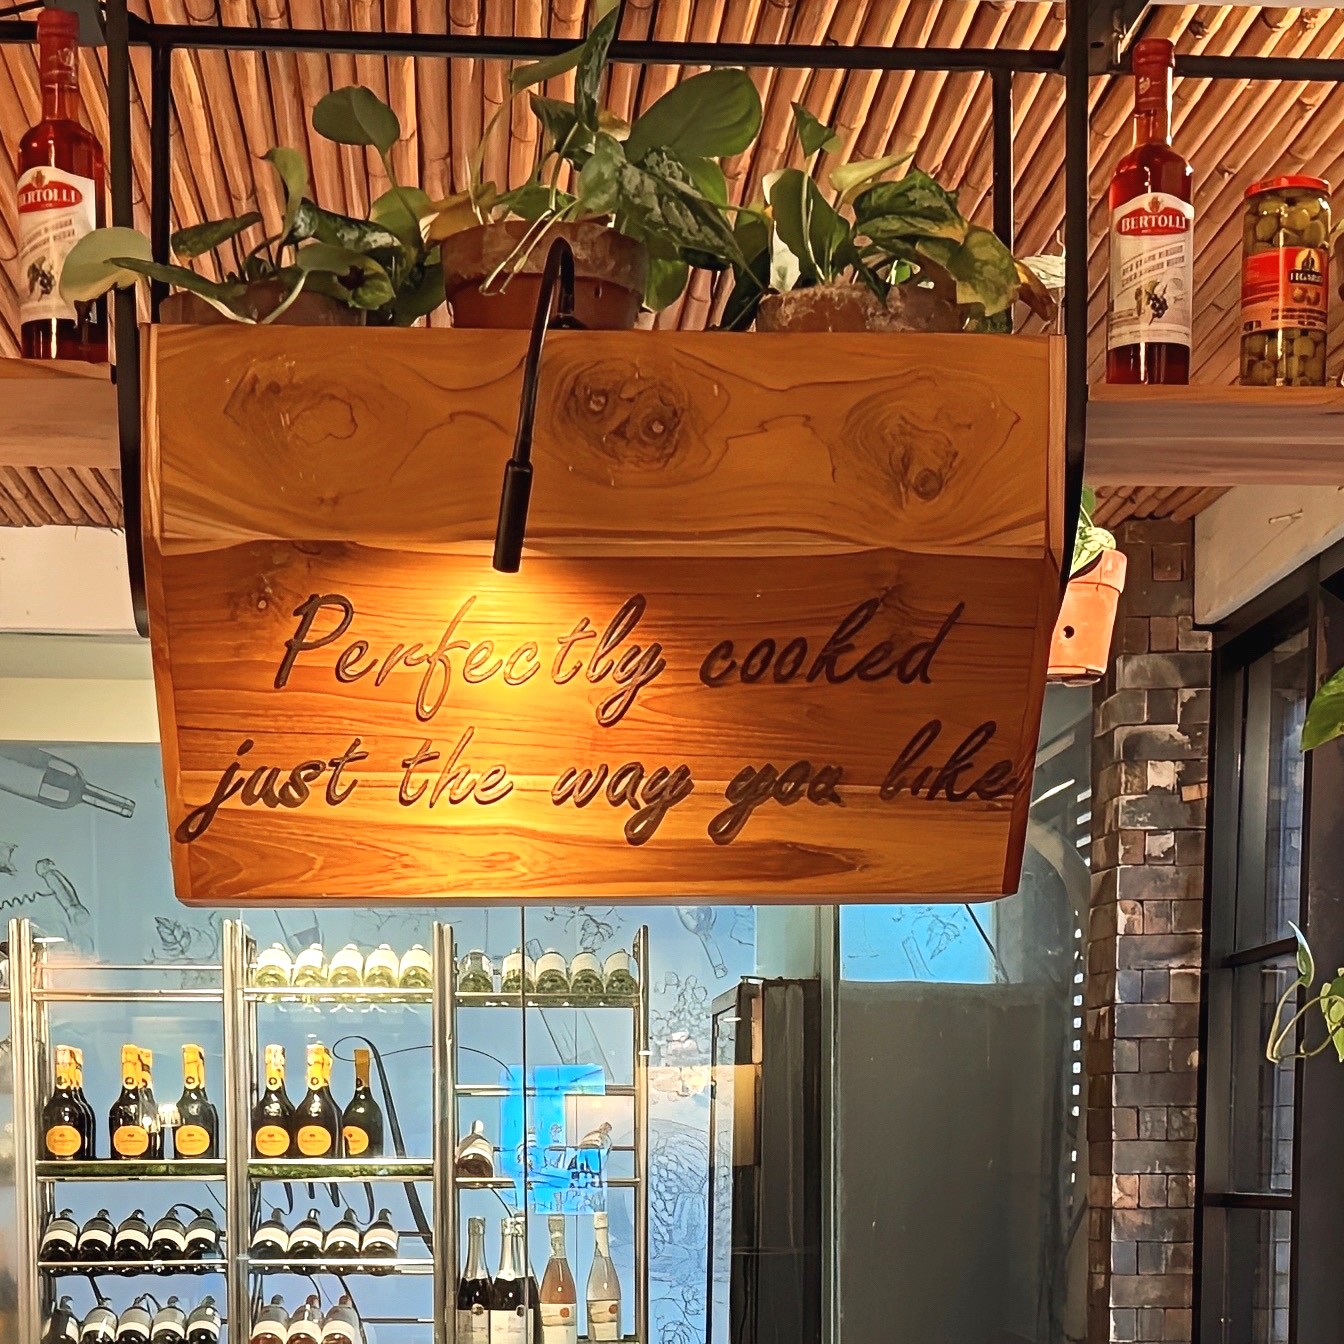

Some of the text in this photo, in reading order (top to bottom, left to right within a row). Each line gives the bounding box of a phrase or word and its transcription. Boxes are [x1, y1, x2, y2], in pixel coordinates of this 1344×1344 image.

[1121, 213, 1187, 233] BERTOLLI
[274, 592, 966, 728] Perfectly cooked
[174, 718, 1022, 847] just the way you like
